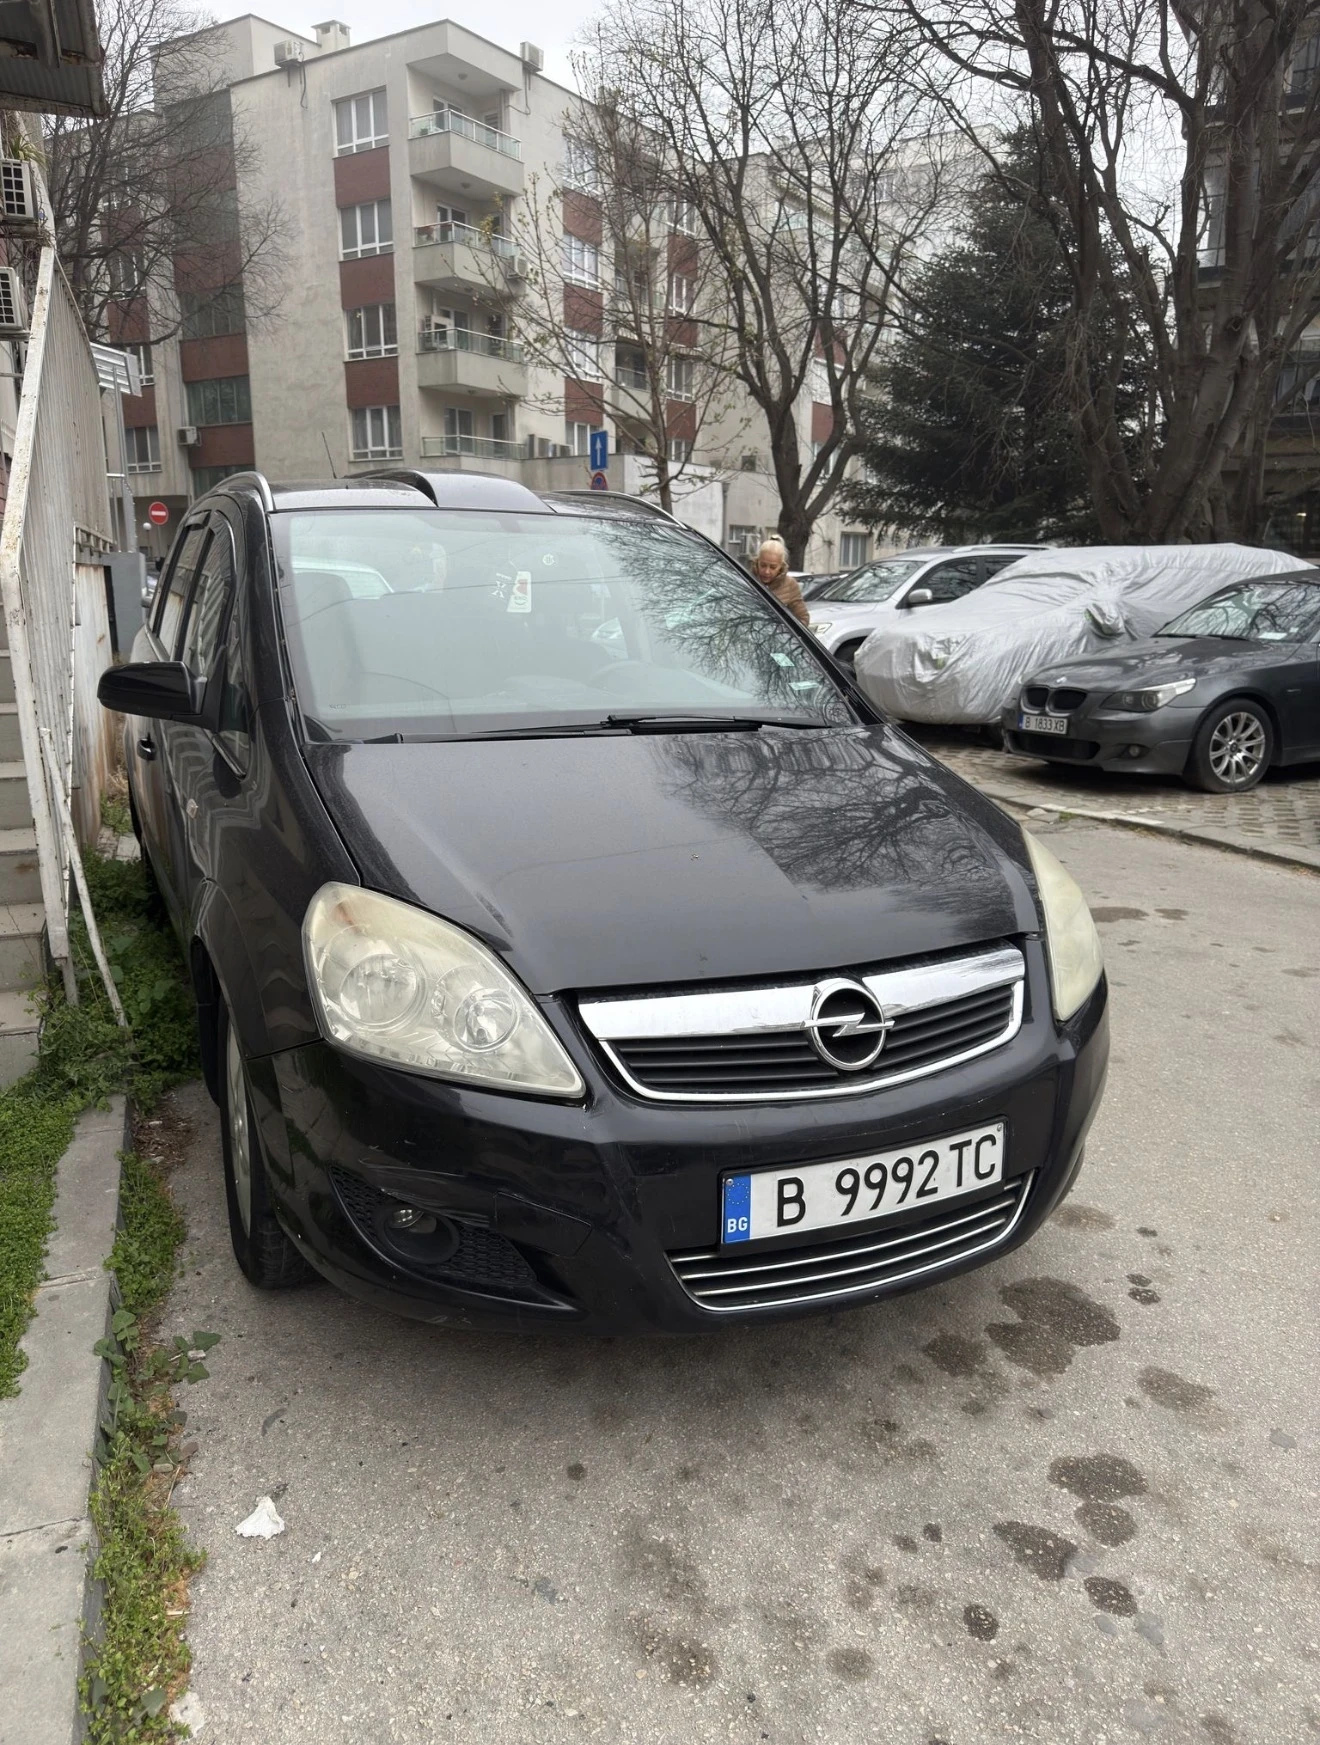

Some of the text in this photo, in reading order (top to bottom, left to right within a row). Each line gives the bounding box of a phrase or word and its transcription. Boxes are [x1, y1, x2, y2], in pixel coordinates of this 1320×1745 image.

[1025, 716, 1030, 728] B
[776, 1133, 997, 1228] B 9992 TC
[727, 1217, 748, 1233] BG
